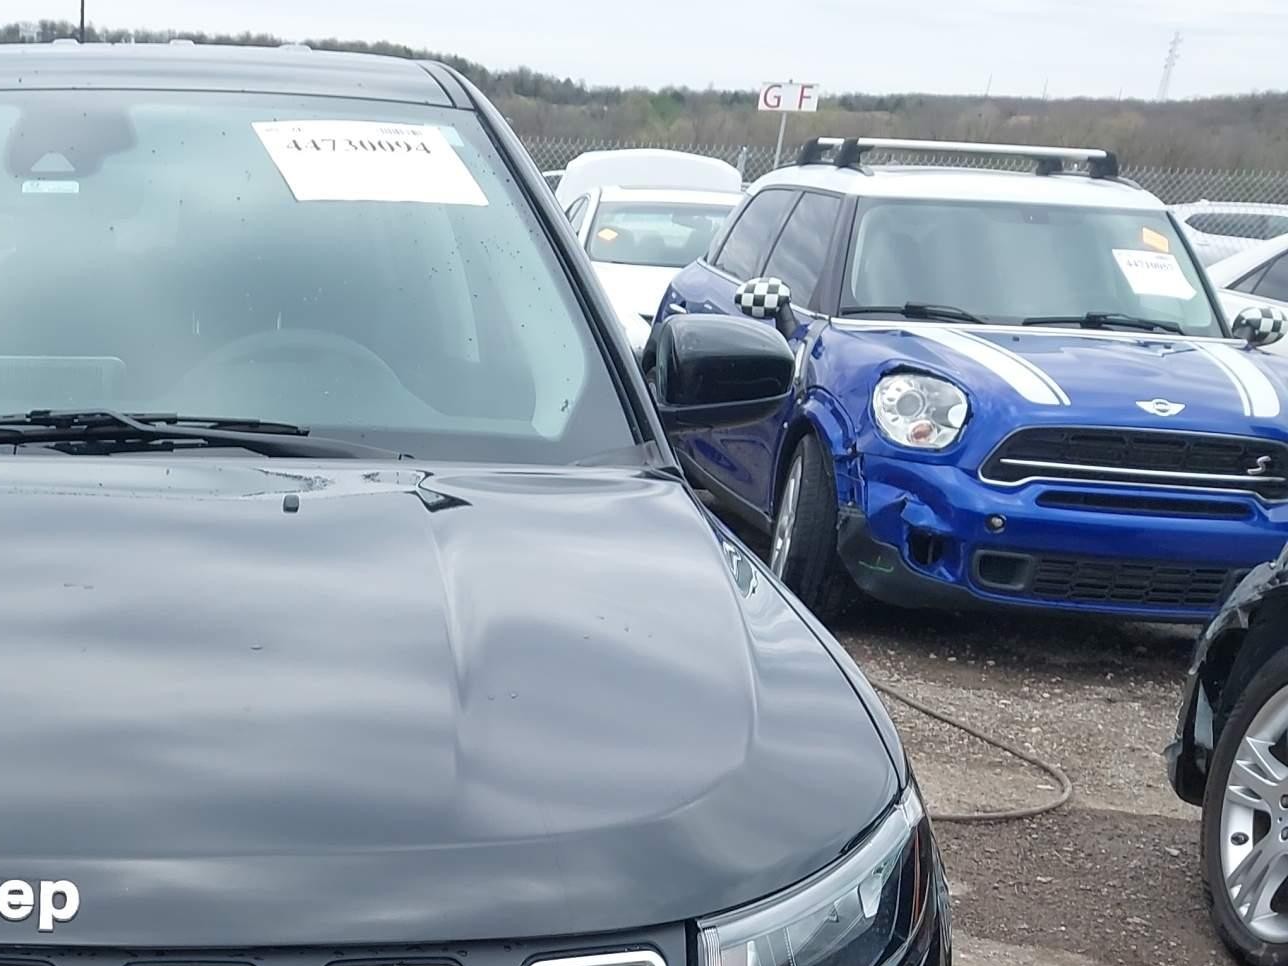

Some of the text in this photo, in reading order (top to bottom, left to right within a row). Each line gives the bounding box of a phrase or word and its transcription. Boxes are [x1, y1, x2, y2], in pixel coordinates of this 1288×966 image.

[763, 84, 814, 110] G F
[286, 138, 431, 154] 44730094
[1246, 455, 1272, 475] S
